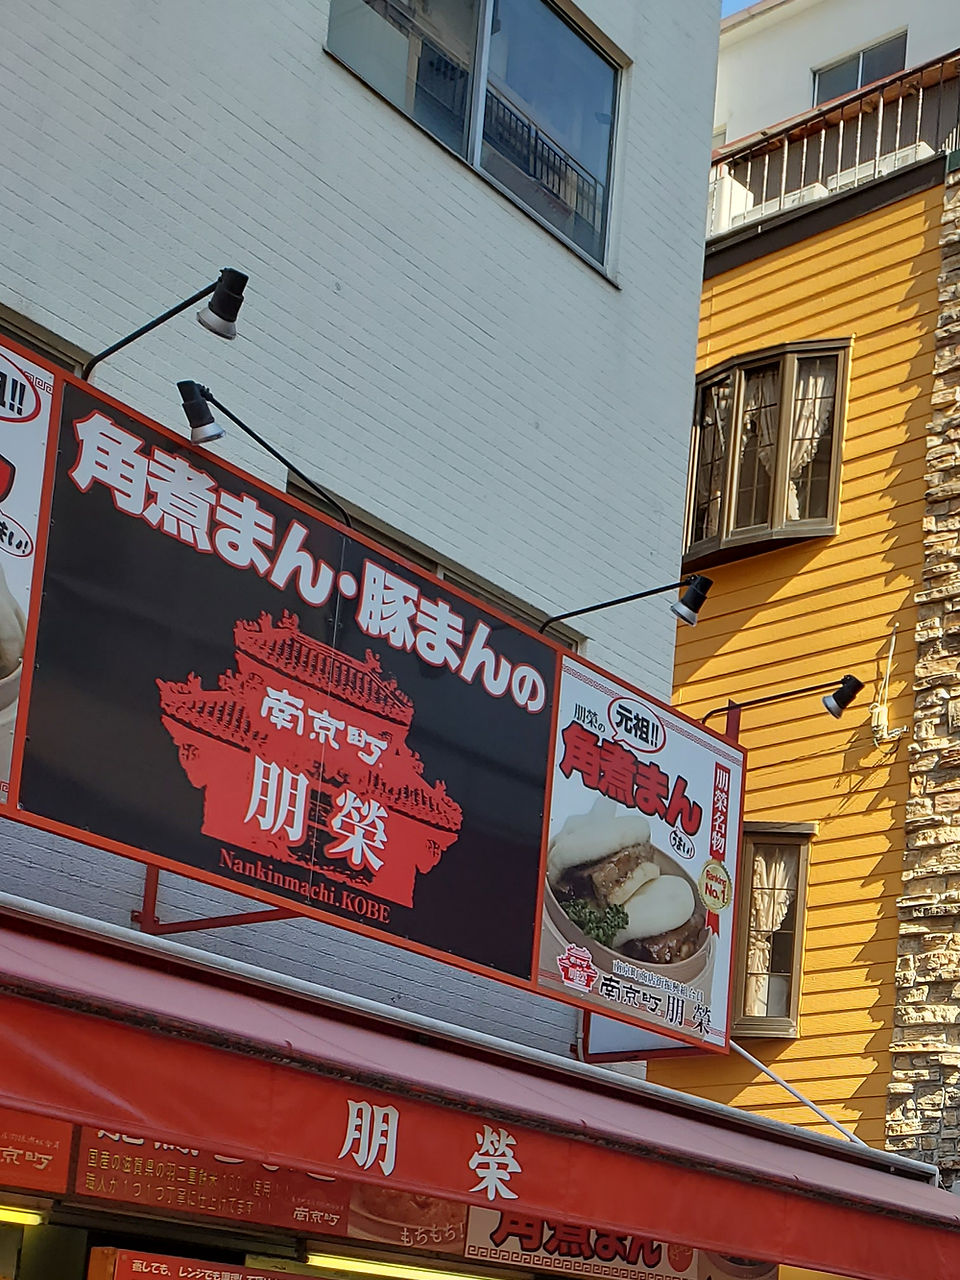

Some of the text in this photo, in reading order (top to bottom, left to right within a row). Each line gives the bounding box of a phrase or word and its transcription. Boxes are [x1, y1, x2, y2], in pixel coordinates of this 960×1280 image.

[71, 410, 546, 714] 角煮まん・豚まんの
[259, 685, 388, 768] 南京町
[559, 720, 703, 838] 角煮まん
[244, 755, 389, 872] 朋榮
[599, 975, 662, 1013] 南京町
